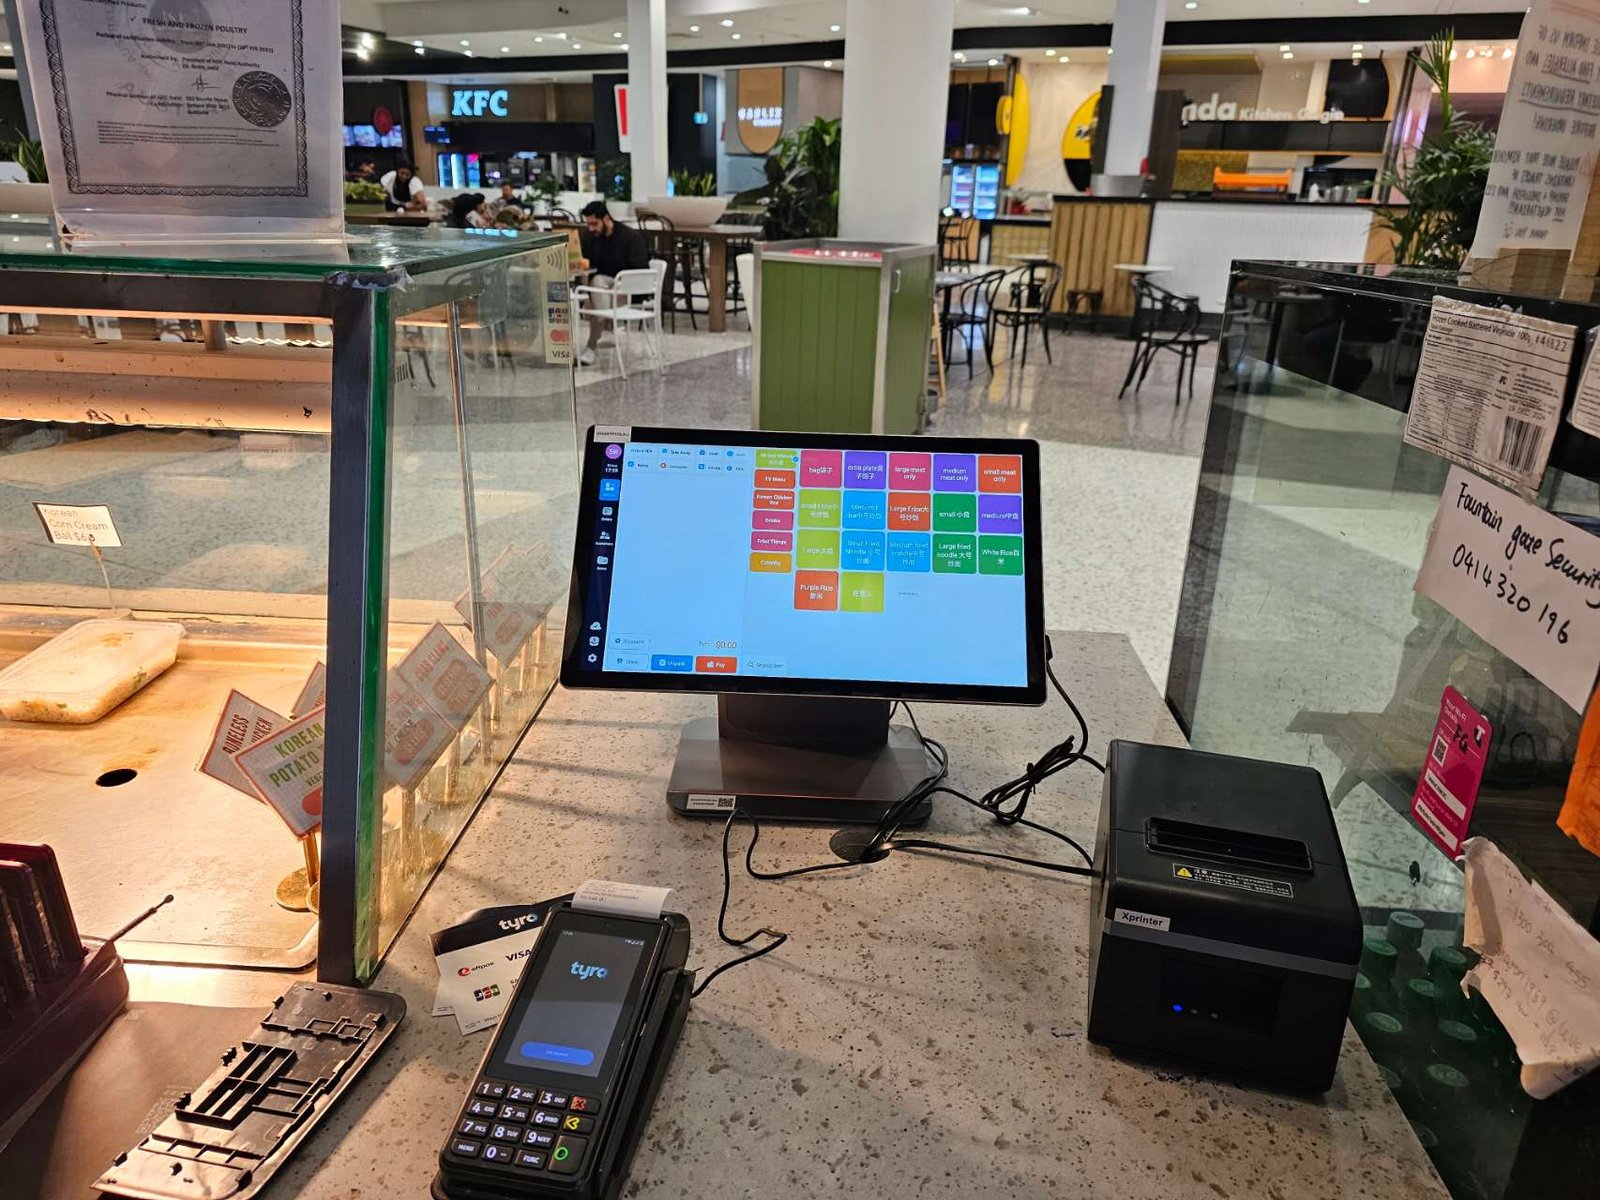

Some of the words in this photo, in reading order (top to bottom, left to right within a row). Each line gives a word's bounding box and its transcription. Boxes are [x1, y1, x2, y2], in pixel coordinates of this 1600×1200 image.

[143, 17, 166, 27] FRESH
[167, 20, 185, 28] AND
[186, 21, 214, 31] FROZEN
[215, 24, 248, 34] POULTRY
[451, 89, 508, 117] KFC
[1181, 93, 1237, 121] nda
[1448, 316, 1468, 329] Cooked
[552, 350, 570, 359] VISA
[894, 466, 910, 474] large
[956, 474, 969, 482] only
[44, 508, 79, 517] Korean
[889, 505, 907, 513] Large
[1456, 482, 1504, 533] Fountain
[49, 518, 72, 529] Corn
[74, 520, 109, 530] Cream
[54, 531, 72, 541] Ball
[800, 584, 819, 592] Purple
[1452, 543, 1494, 588] 0414
[1497, 573, 1532, 613] 320
[1538, 604, 1569, 644] 196
[715, 661, 726, 669] Pay
[251, 716, 273, 744] HICKEN
[274, 721, 324, 759] KOREAN
[268, 750, 319, 788] POTATO
[499, 913, 539, 930] tyro
[1121, 911, 1164, 928] Xprinter
[505, 949, 532, 962] VISA
[570, 961, 608, 980] tyro
[482, 1083, 489, 1094] 1
[511, 1088, 520, 1099] 2
[542, 1093, 551, 1103] 3
[472, 1103, 481, 1113] 4
[503, 1107, 512, 1118] 5
[535, 1112, 544, 1123] 6
[464, 1121, 474, 1132] 7
[495, 1126, 504, 1138] 8
[528, 1131, 537, 1143] 9
[486, 1146, 497, 1159] 0
[523, 1155, 540, 1164] FUNC
